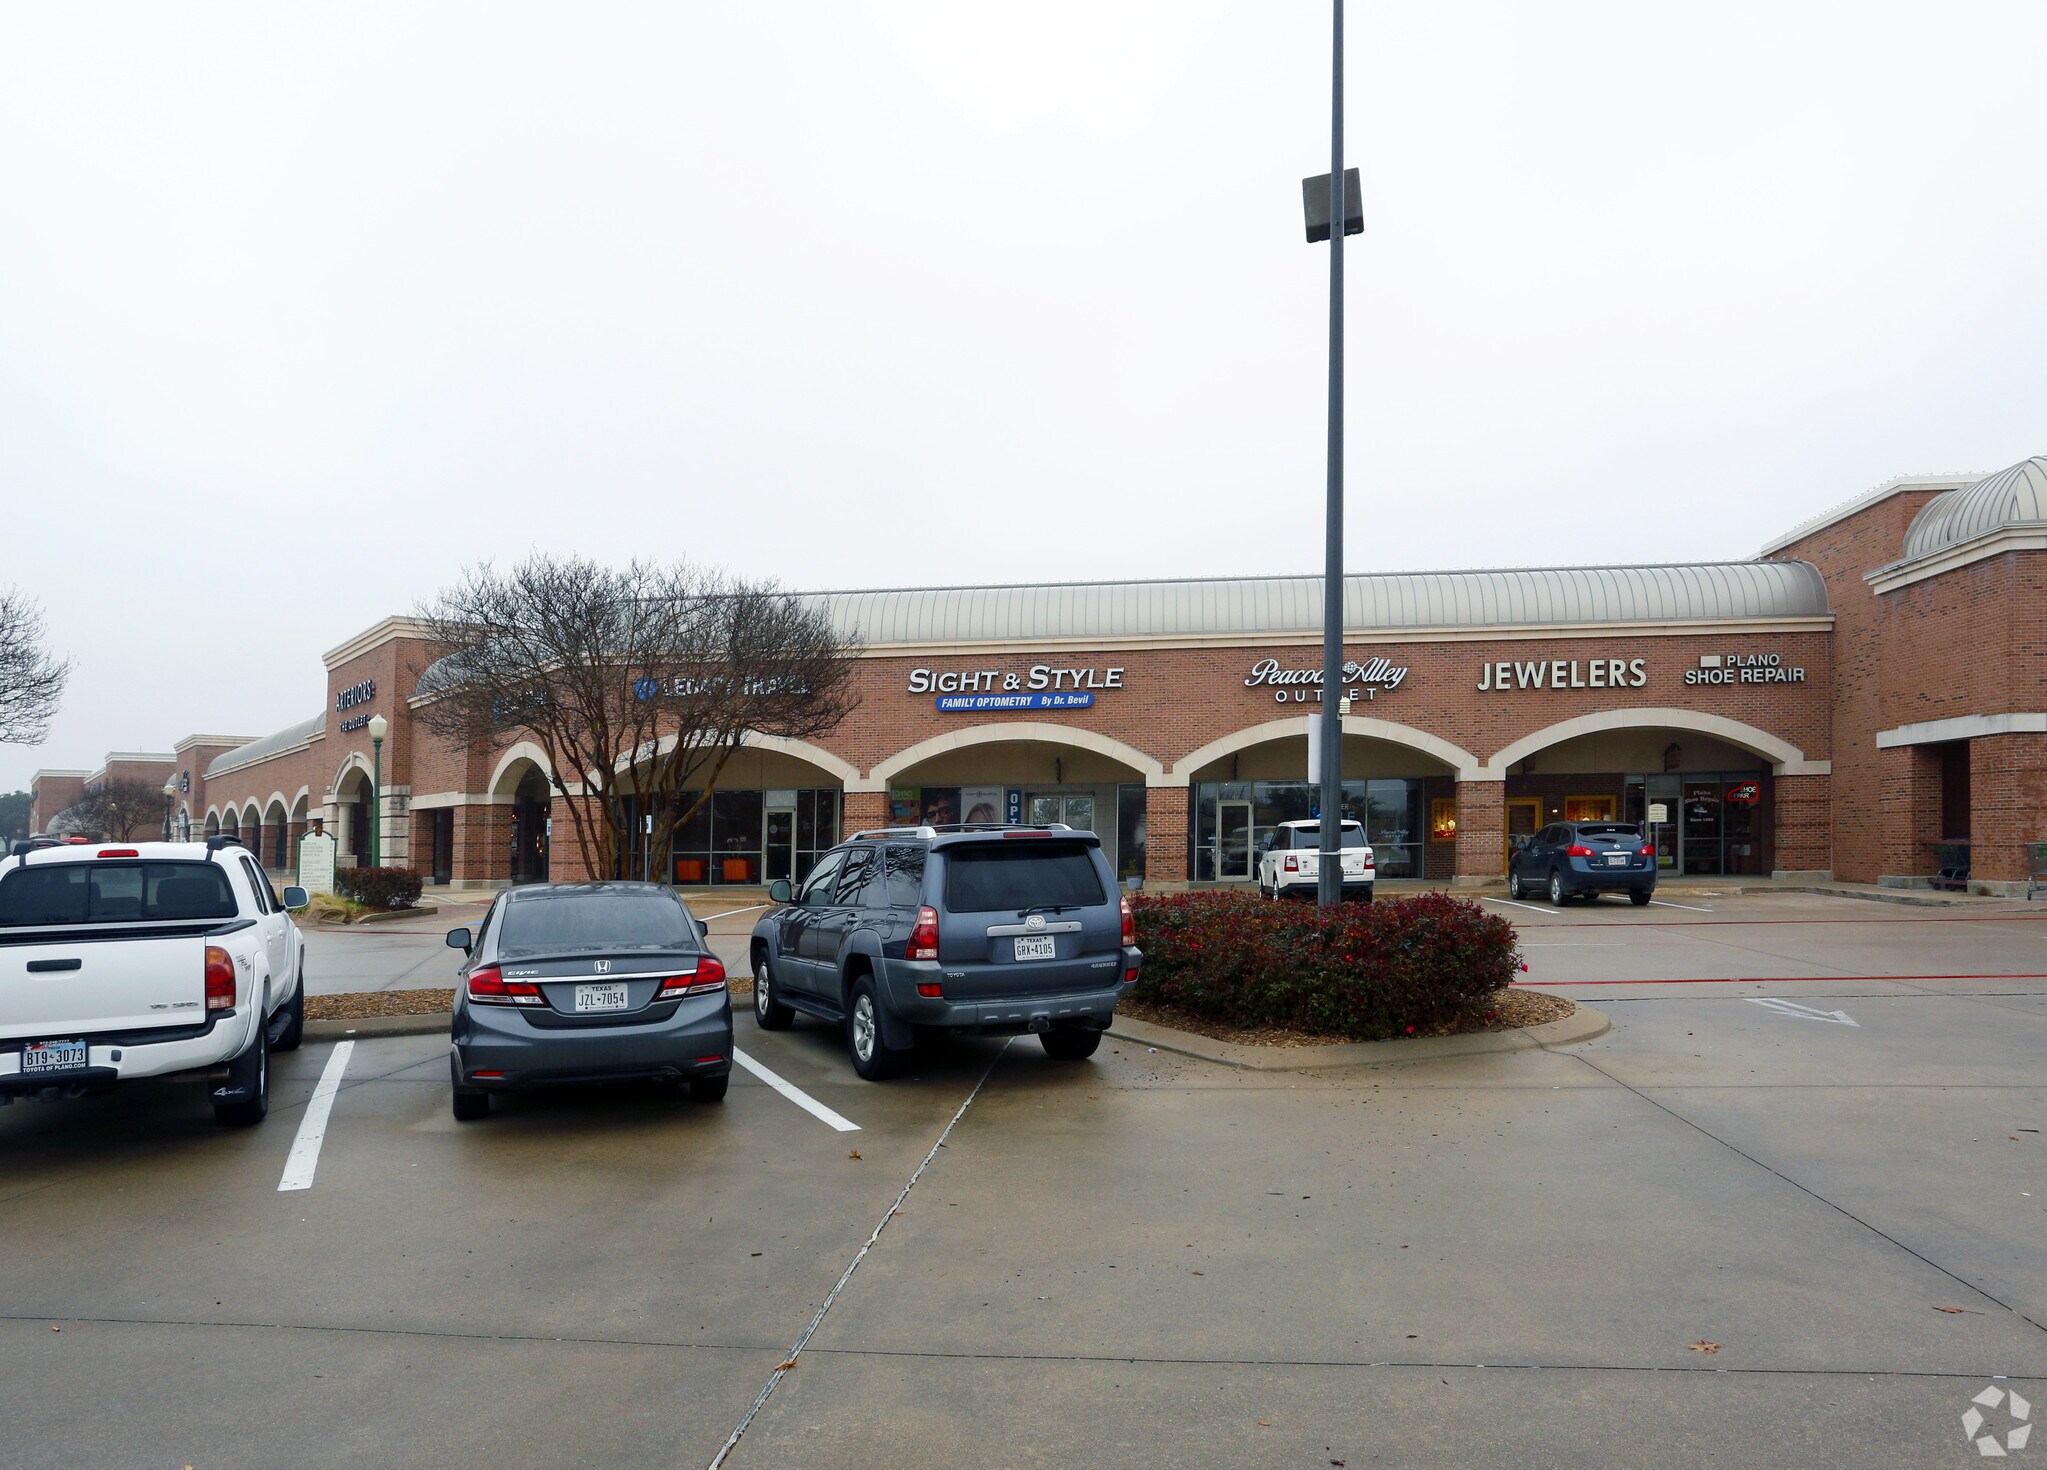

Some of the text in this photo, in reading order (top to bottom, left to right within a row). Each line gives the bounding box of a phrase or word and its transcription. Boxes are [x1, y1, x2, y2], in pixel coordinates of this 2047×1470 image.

[1727, 654, 1780, 667] PLANO
[907, 665, 1125, 693] SIGHT & STYLE
[1244, 656, 1408, 689] Peacoc Alley
[1477, 658, 1648, 692] JEWELERS
[1685, 667, 1805, 684] SHOE REPAIR
[336, 679, 372, 712] ARTERIORS
[941, 695, 1089, 708] FAMILY OPTOMETRY By Dr. Bevil
[1275, 687, 1377, 703] OUTET
[23, 1065, 45, 1073] TOYOTA
